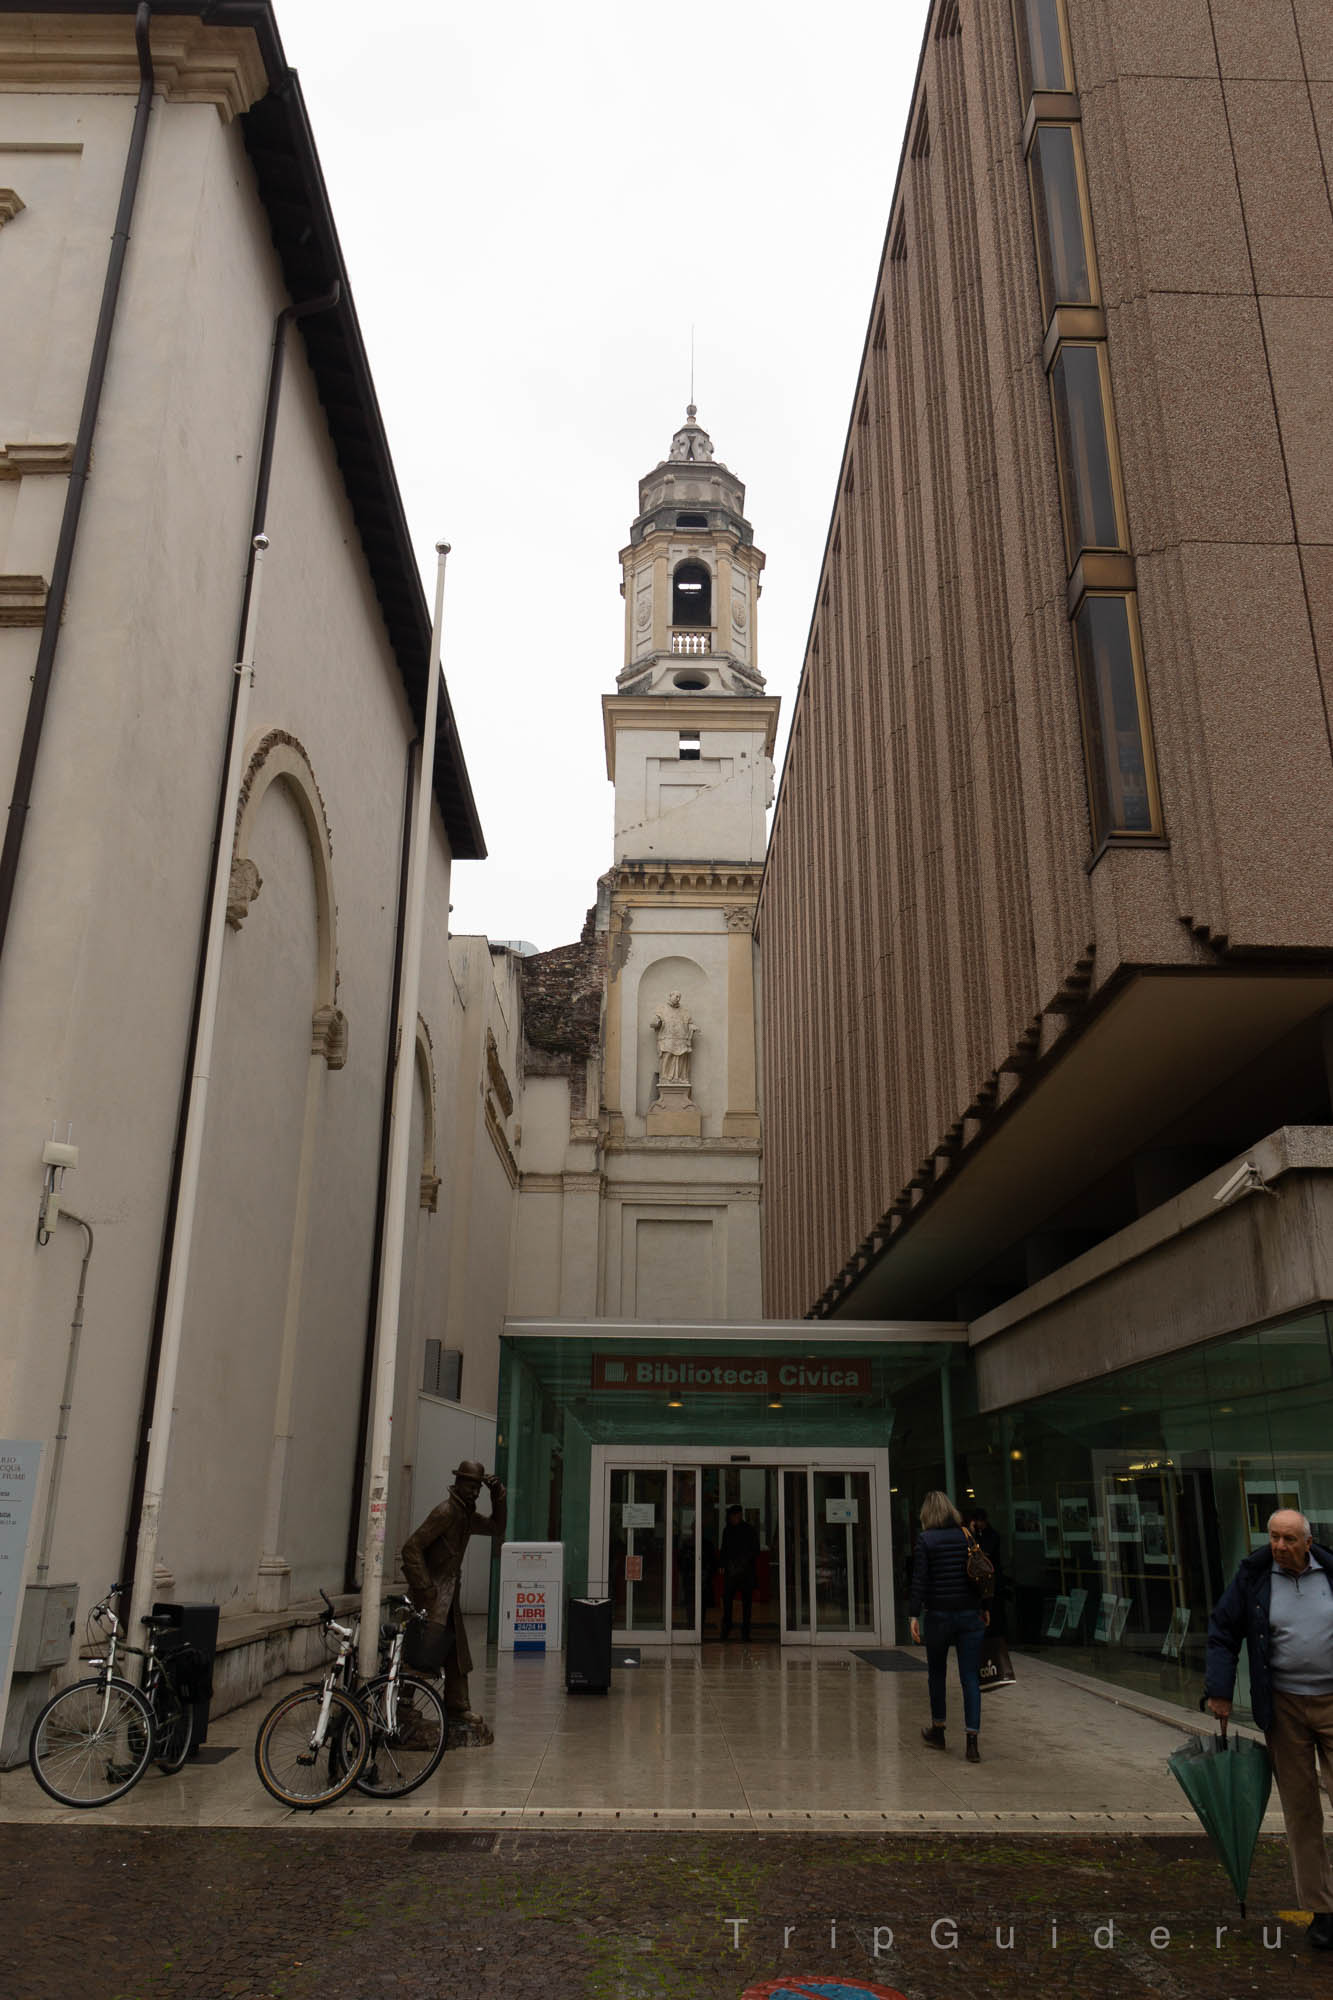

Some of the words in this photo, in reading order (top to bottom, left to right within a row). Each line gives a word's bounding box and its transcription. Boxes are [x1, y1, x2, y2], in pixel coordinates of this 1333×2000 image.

[636, 1362, 768, 1384] Biblioteca
[779, 1365, 859, 1386] Civica
[516, 1592, 545, 1604] BOX
[516, 1608, 545, 1617] LIBRI
